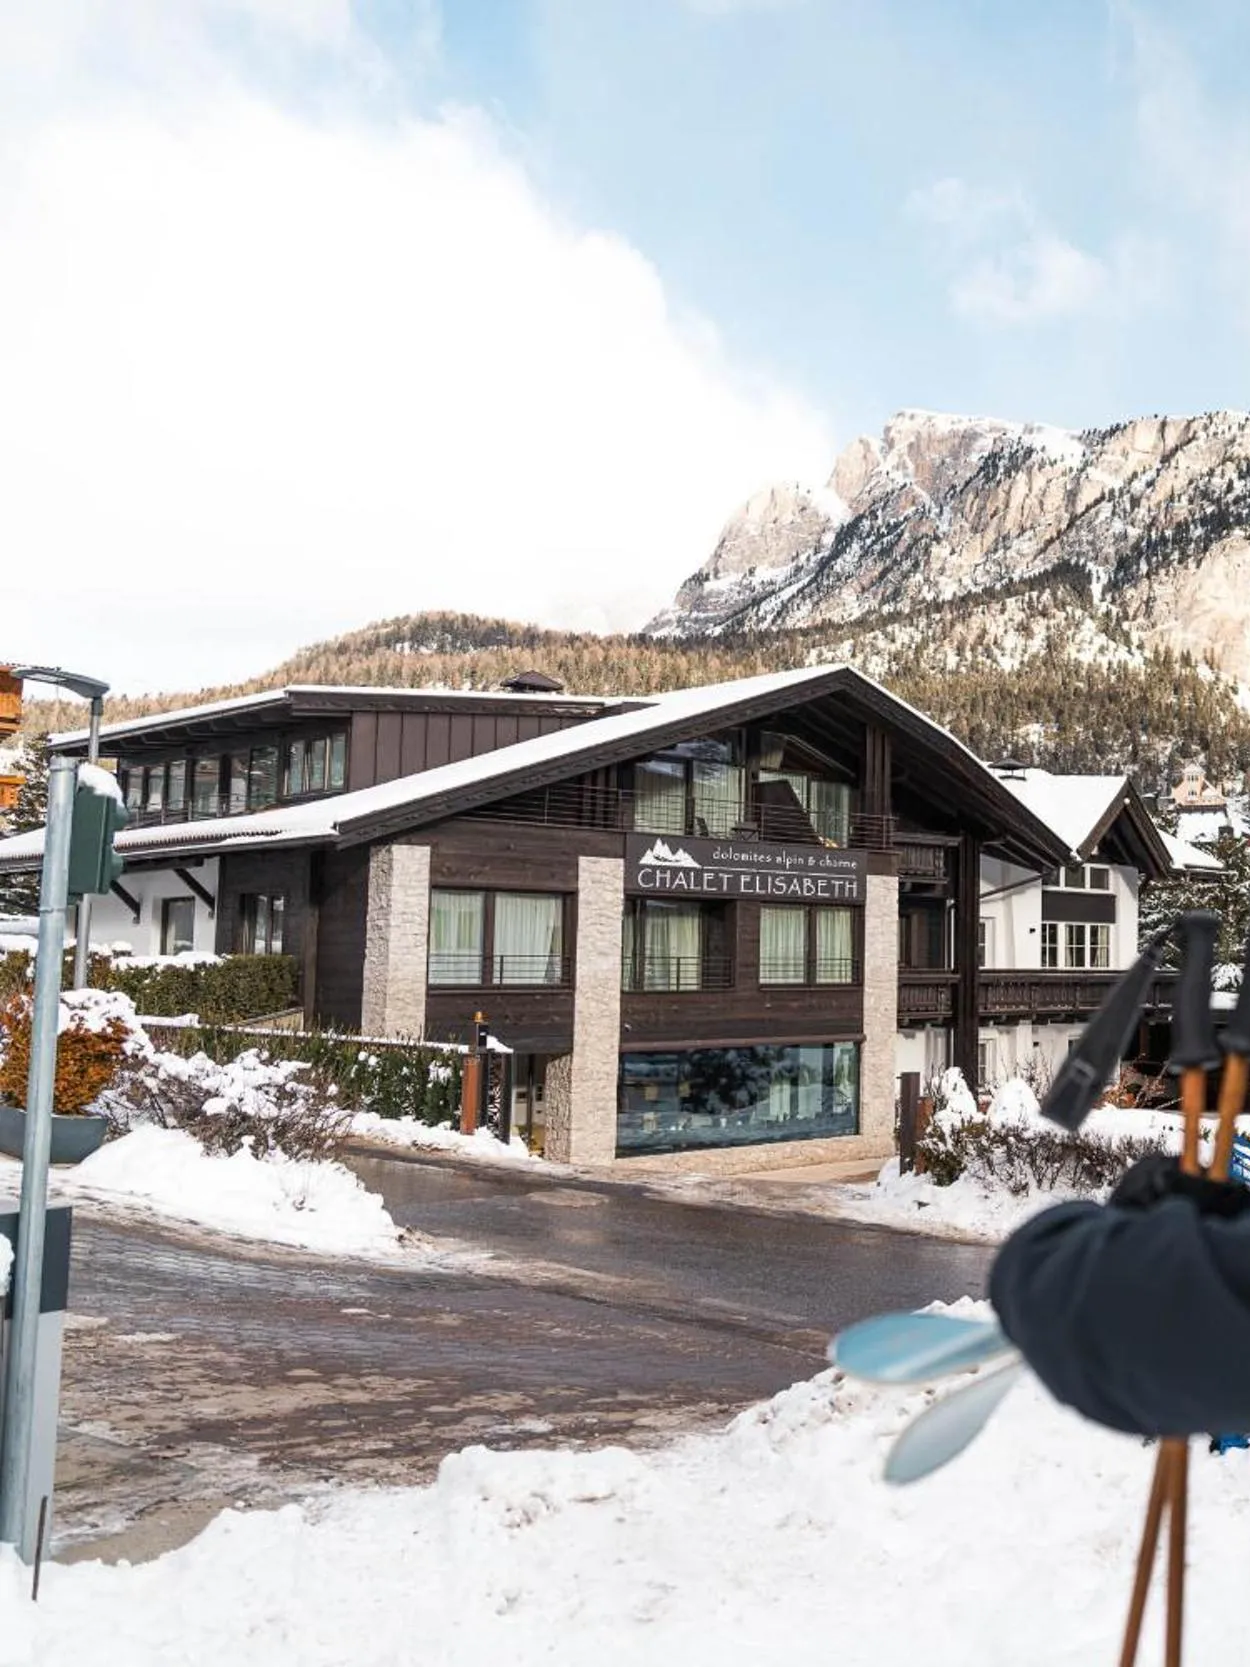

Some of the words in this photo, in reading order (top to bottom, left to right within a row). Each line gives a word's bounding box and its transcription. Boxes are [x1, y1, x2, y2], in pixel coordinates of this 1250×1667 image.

[712, 846, 772, 863] dolomites
[775, 850, 804, 869] alpin
[637, 868, 734, 892] CHALET
[740, 873, 858, 898] ELISABETH
